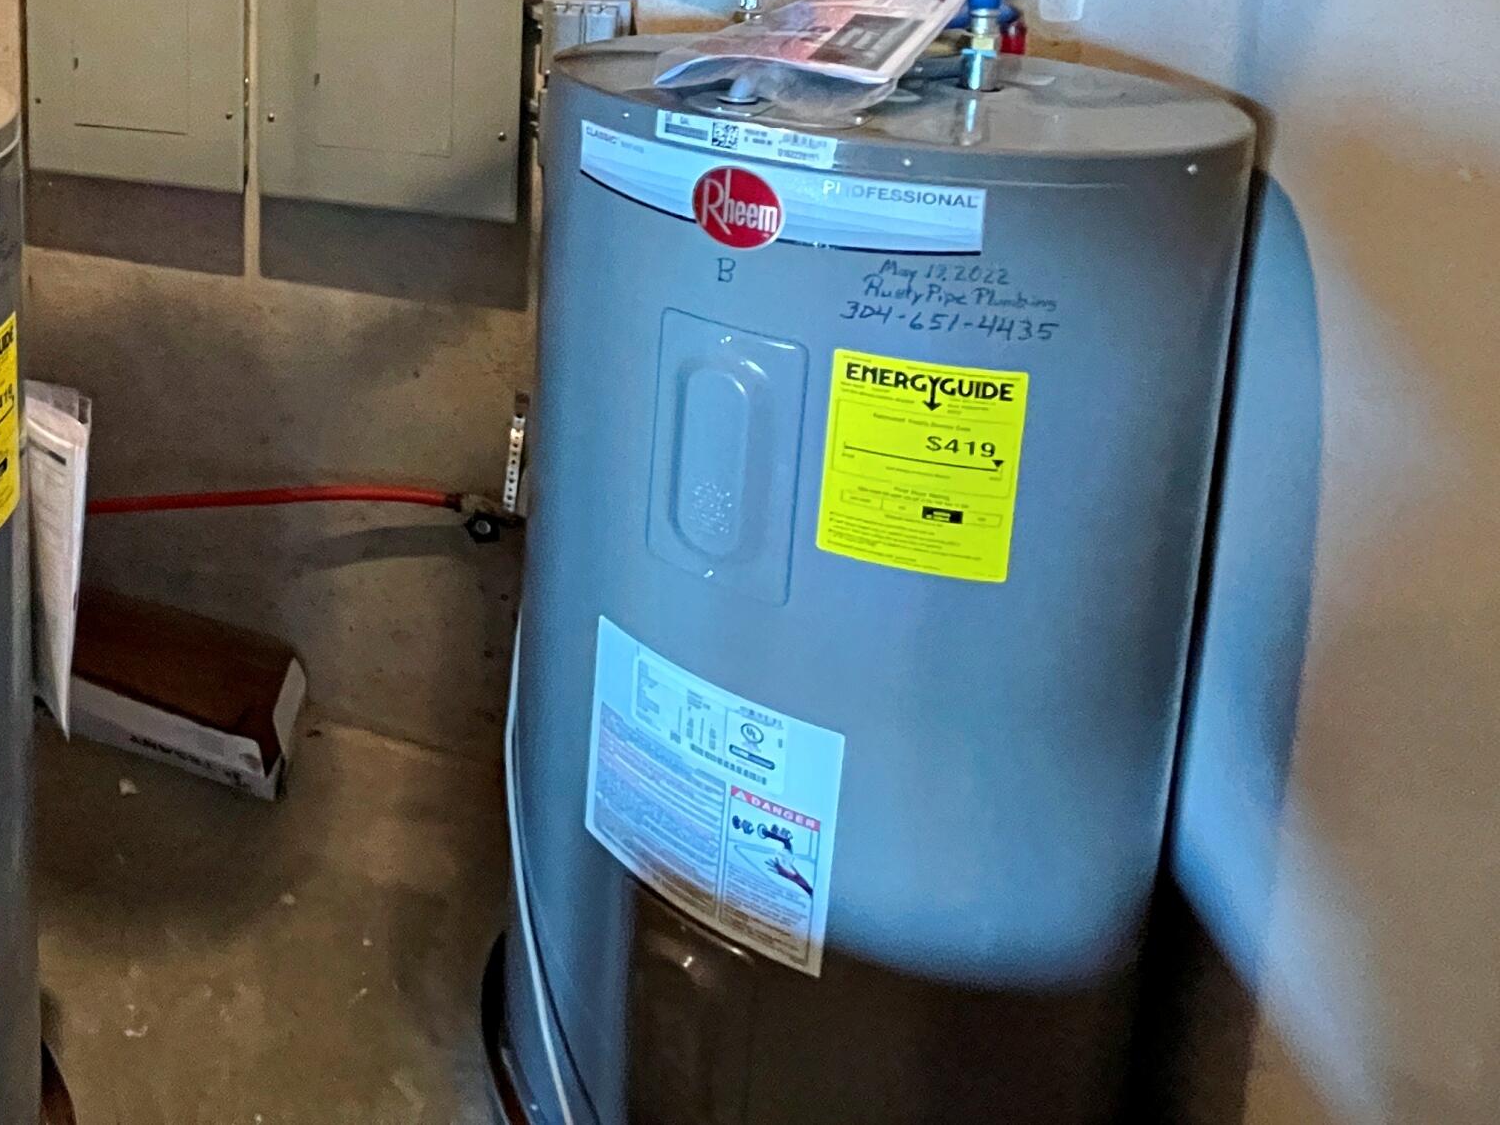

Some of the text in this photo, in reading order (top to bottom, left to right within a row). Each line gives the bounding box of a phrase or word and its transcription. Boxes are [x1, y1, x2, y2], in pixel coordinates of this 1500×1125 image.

[701, 168, 778, 236] Rheem
[717, 257, 736, 283] B
[877, 259, 918, 287] May
[954, 265, 1012, 286] 2022
[925, 283, 967, 307] Pipe
[970, 286, 1059, 313] Plumbing
[839, 300, 1060, 342] 304-651-4435
[846, 361, 1015, 403] ENERGYGUIDE
[750, 795, 817, 829] DANGER
